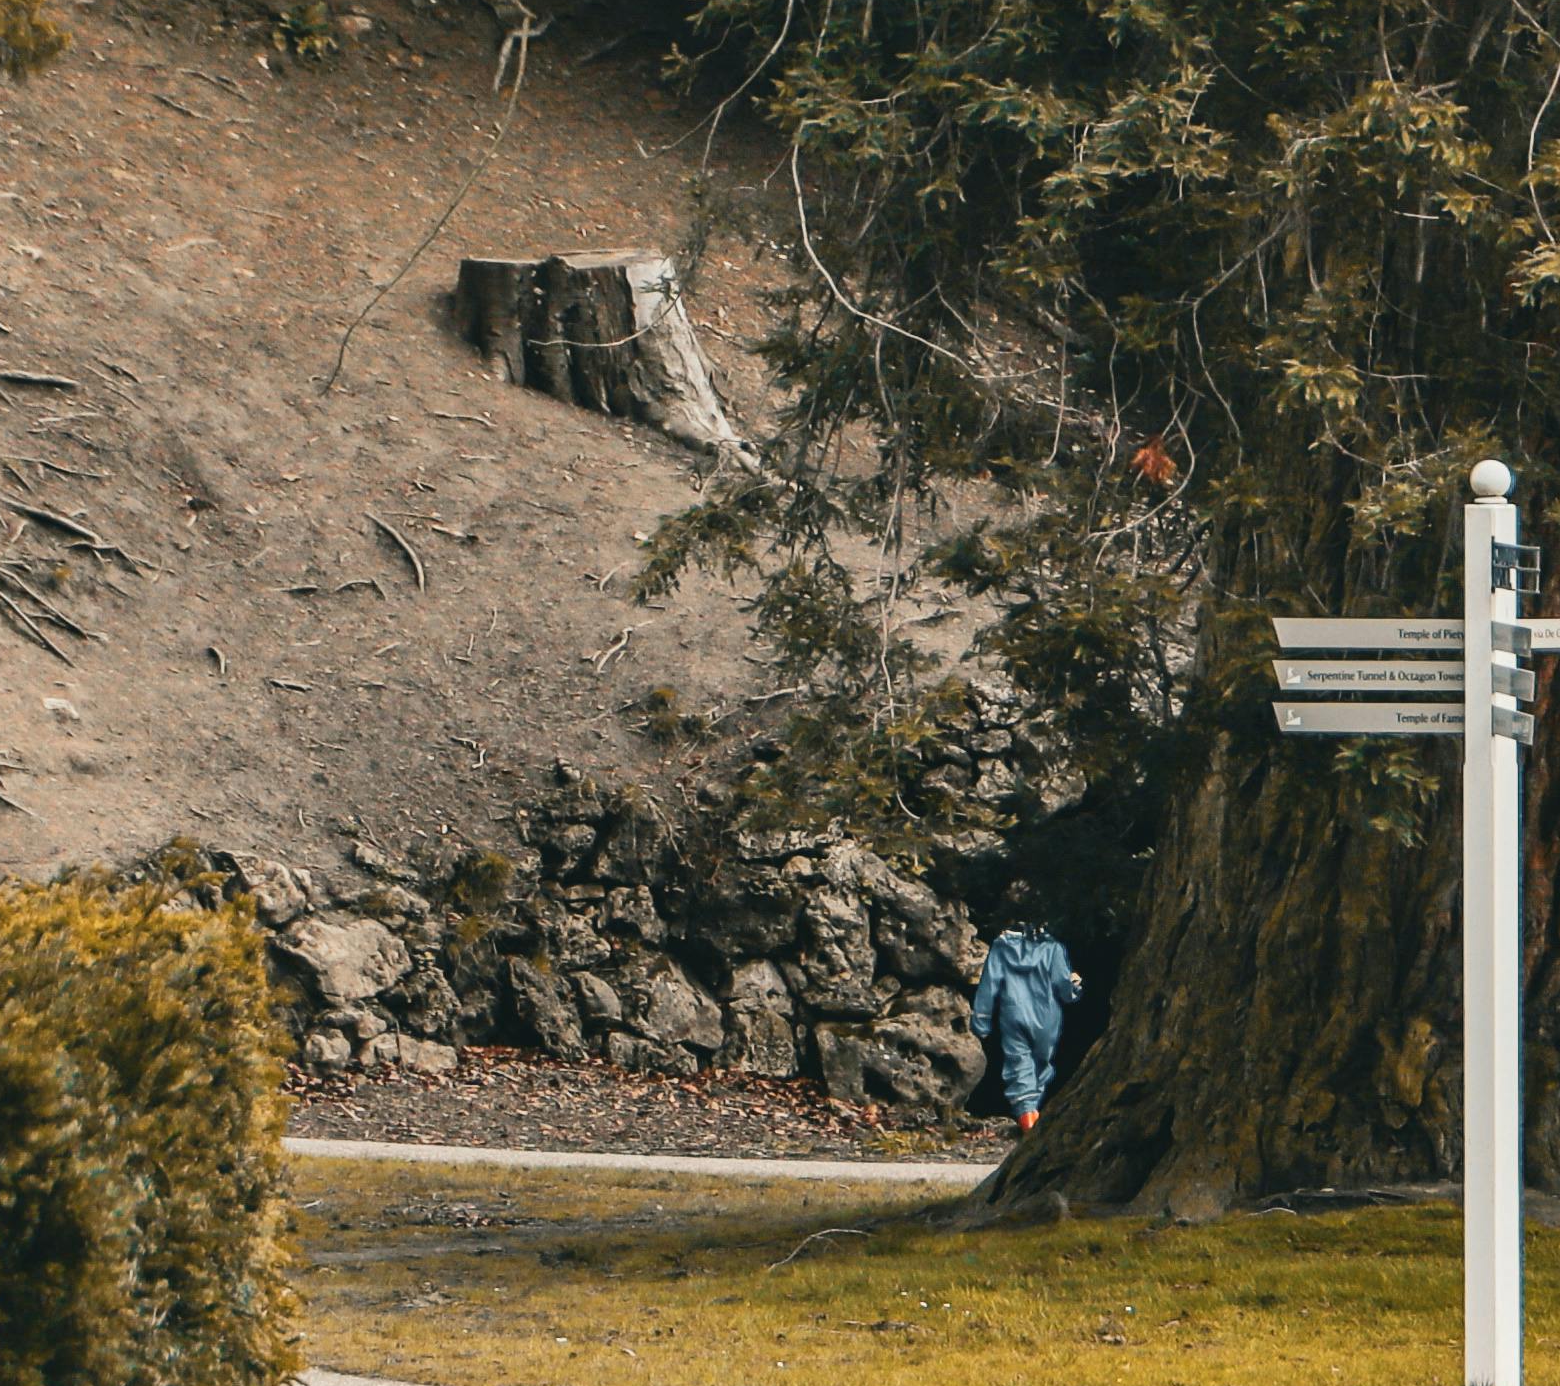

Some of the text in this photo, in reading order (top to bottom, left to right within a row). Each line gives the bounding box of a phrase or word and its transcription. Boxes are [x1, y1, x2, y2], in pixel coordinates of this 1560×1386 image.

[1398, 628, 1464, 641] Temple of Piety
[1545, 629, 1555, 638] De
[1307, 670, 1355, 683] Serpentine
[1357, 670, 1387, 681] Tunnel
[1389, 671, 1396, 681] &
[1398, 670, 1436, 683] Octagon
[1396, 712, 1428, 724] Temple
[1430, 712, 1440, 723] of
